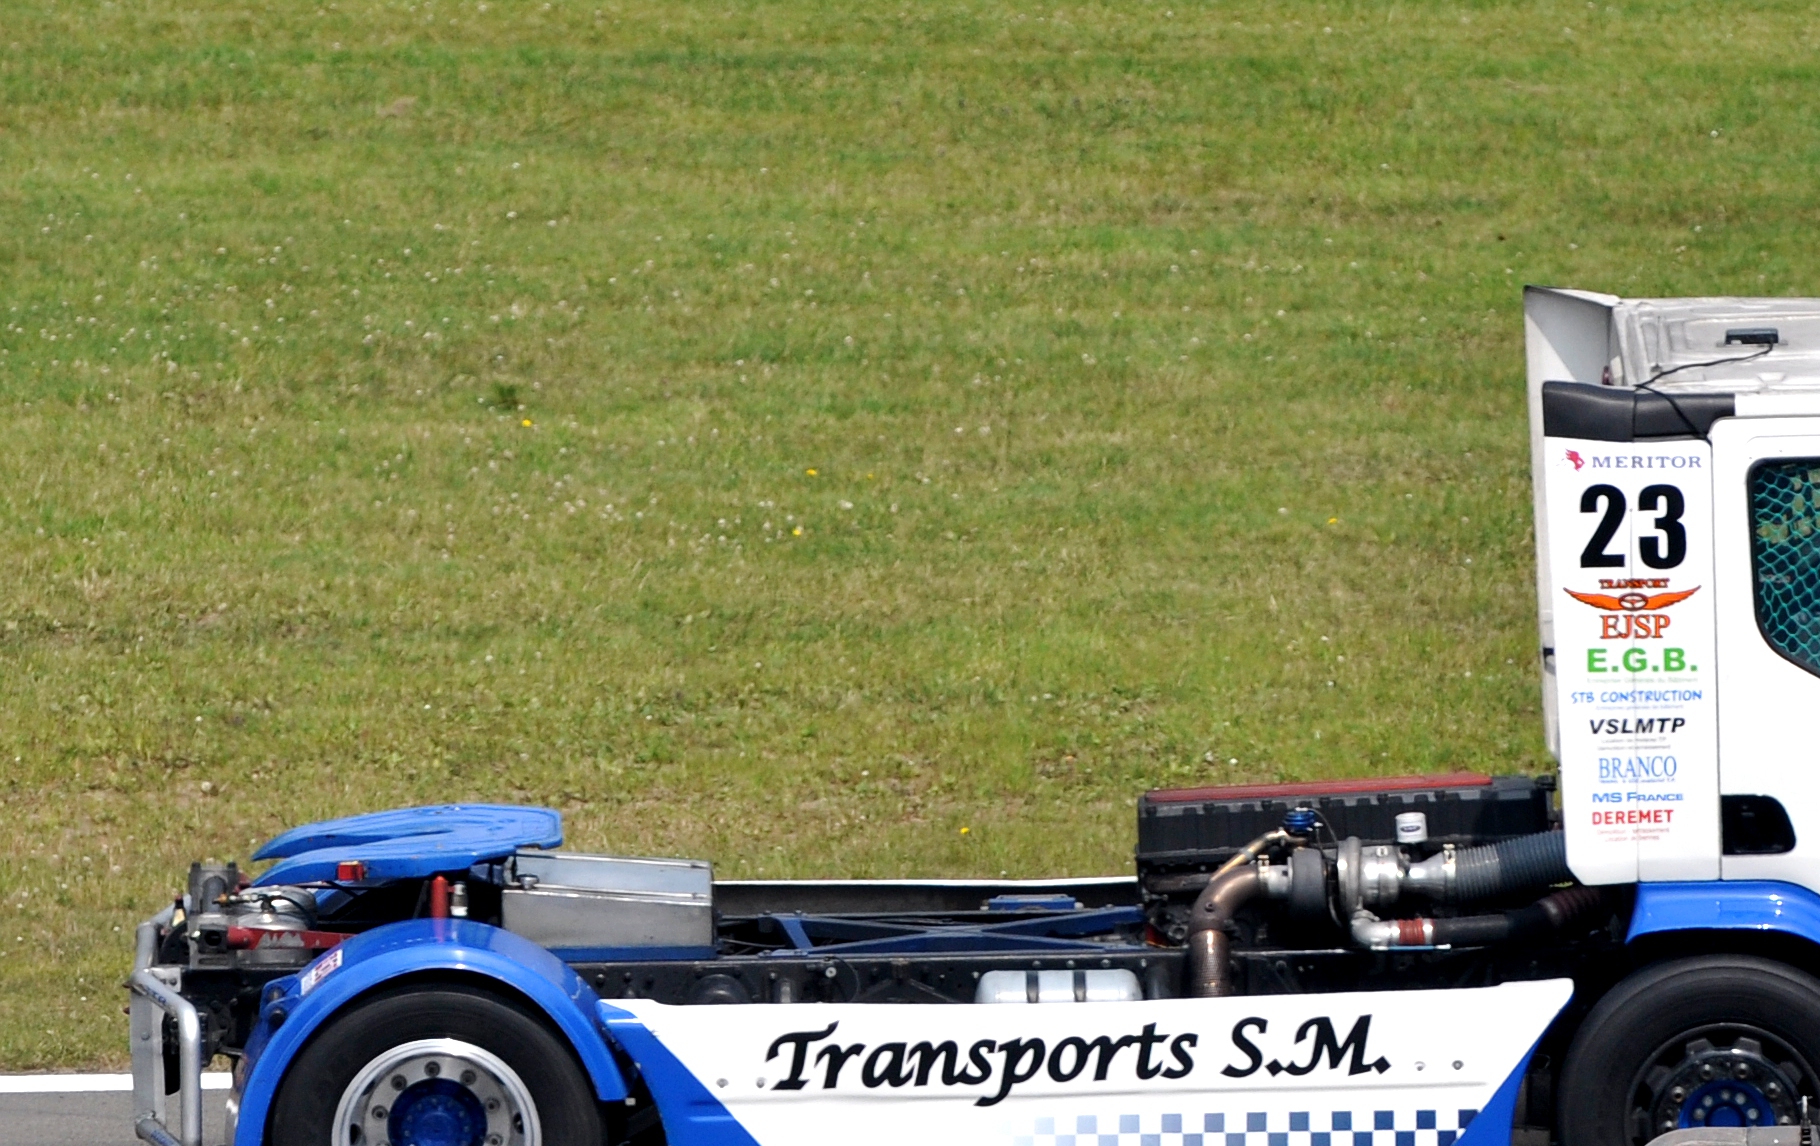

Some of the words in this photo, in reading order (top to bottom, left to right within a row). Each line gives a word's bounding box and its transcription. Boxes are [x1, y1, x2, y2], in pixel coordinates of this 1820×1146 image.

[1592, 456, 1702, 468] MERITOR
[1579, 483, 1687, 570] 23
[1598, 578, 1670, 589] TRANSPORT
[1599, 614, 1671, 639] EJSP
[1587, 648, 1698, 672] E.G.B.
[1571, 691, 1595, 704] STB
[1600, 690, 1702, 703] CONSTRUCTION
[1589, 717, 1686, 734] VSLMTP
[1598, 755, 1677, 779] BRANCO
[1592, 792, 1622, 803] MS
[1592, 809, 1674, 825] DEREMET
[765, 1020, 1199, 1106] Transports
[1221, 1013, 1392, 1078] S.M.
